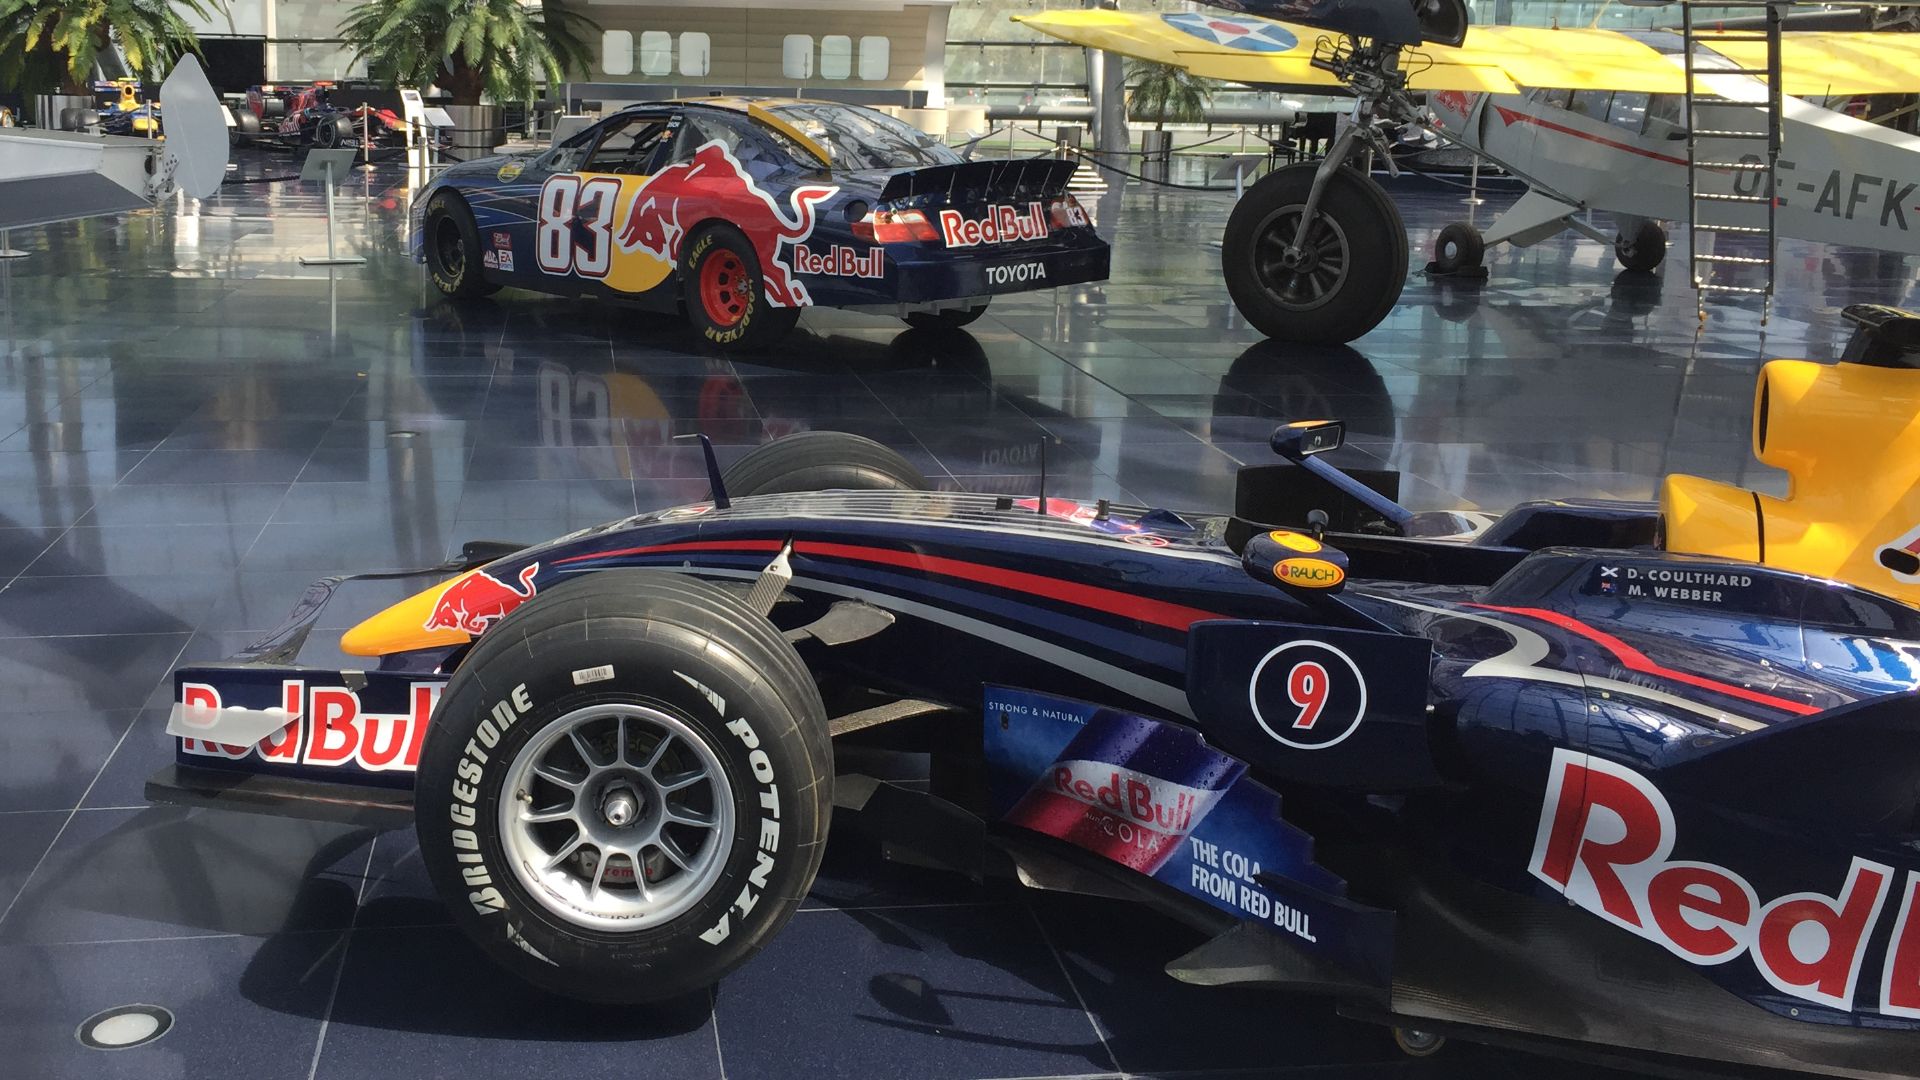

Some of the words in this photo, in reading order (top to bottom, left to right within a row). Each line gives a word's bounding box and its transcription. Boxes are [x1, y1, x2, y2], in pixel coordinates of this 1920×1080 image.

[1733, 153, 1918, 231] OE-AFK
[536, 173, 623, 280] 83
[939, 204, 998, 248] Red
[998, 202, 1048, 243] Bull
[1067, 206, 1085, 227] 83
[688, 234, 713, 270] EAGLE
[794, 244, 838, 275] Red
[839, 246, 884, 279] Bull
[986, 262, 1046, 285] TOYOTA
[1291, 566, 1334, 581] RAUCH
[1627, 568, 1644, 580] D.
[1648, 570, 1752, 588] COULTHARD
[1628, 585, 1647, 597] M.
[1654, 586, 1723, 602] WEBBER
[989, 701, 1028, 715] STRONG
[1032, 707, 1039, 717] &
[1287, 660, 1330, 729] 9
[303, 682, 450, 772] Bul
[450, 682, 533, 916] BRIDGESTONE
[1054, 767, 1125, 813] Red
[1126, 777, 1195, 831] Bull
[1102, 815, 1159, 852] COLA
[1189, 836, 1219, 869] THE
[1541, 756, 1888, 1006] Red
[1191, 863, 1237, 906] FROM
[1240, 885, 1271, 919] RED
[1274, 901, 1317, 943] BULL.
